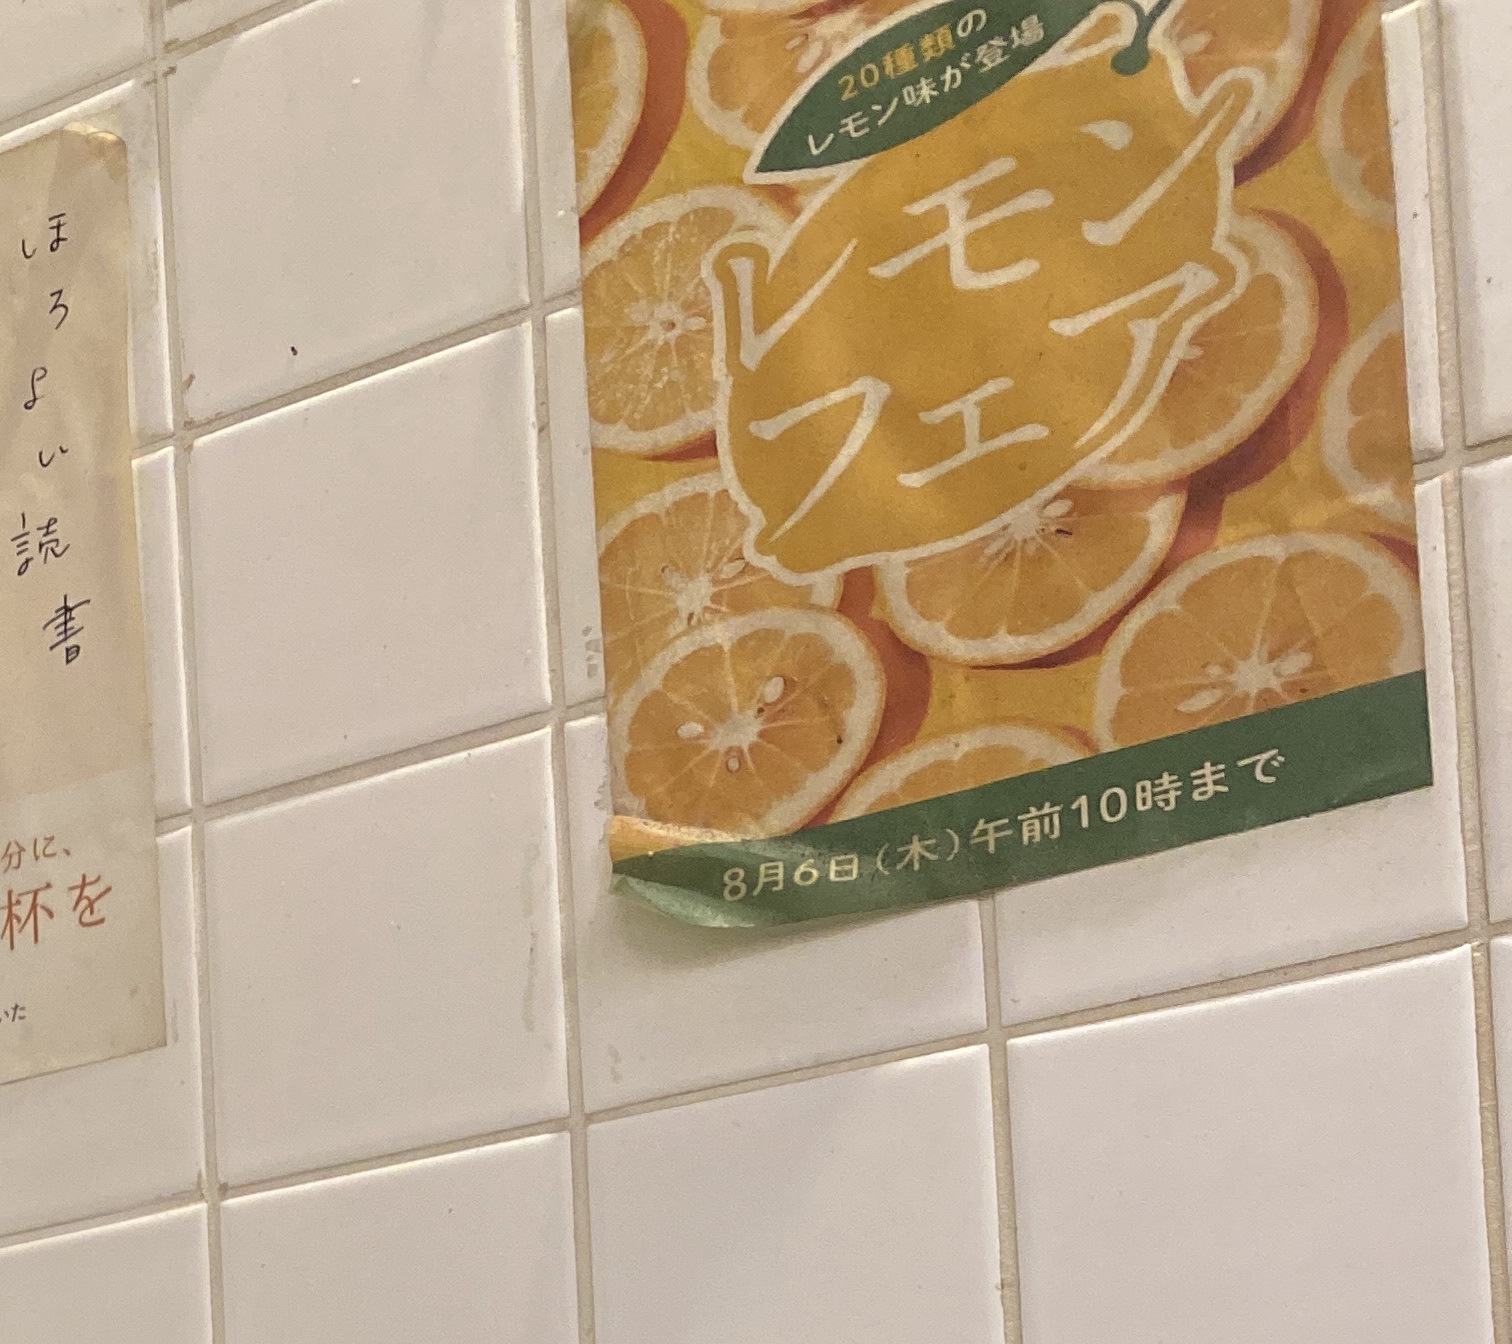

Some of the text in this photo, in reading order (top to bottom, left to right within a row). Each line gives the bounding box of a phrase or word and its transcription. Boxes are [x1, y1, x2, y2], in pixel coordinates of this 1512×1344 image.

[807, 14, 1045, 156] レモン味が登場
[838, 8, 988, 101] 20種類の
[726, 95, 1237, 370] レモン
[11, 211, 91, 667] ほろよい読書
[751, 262, 1220, 545] フェア
